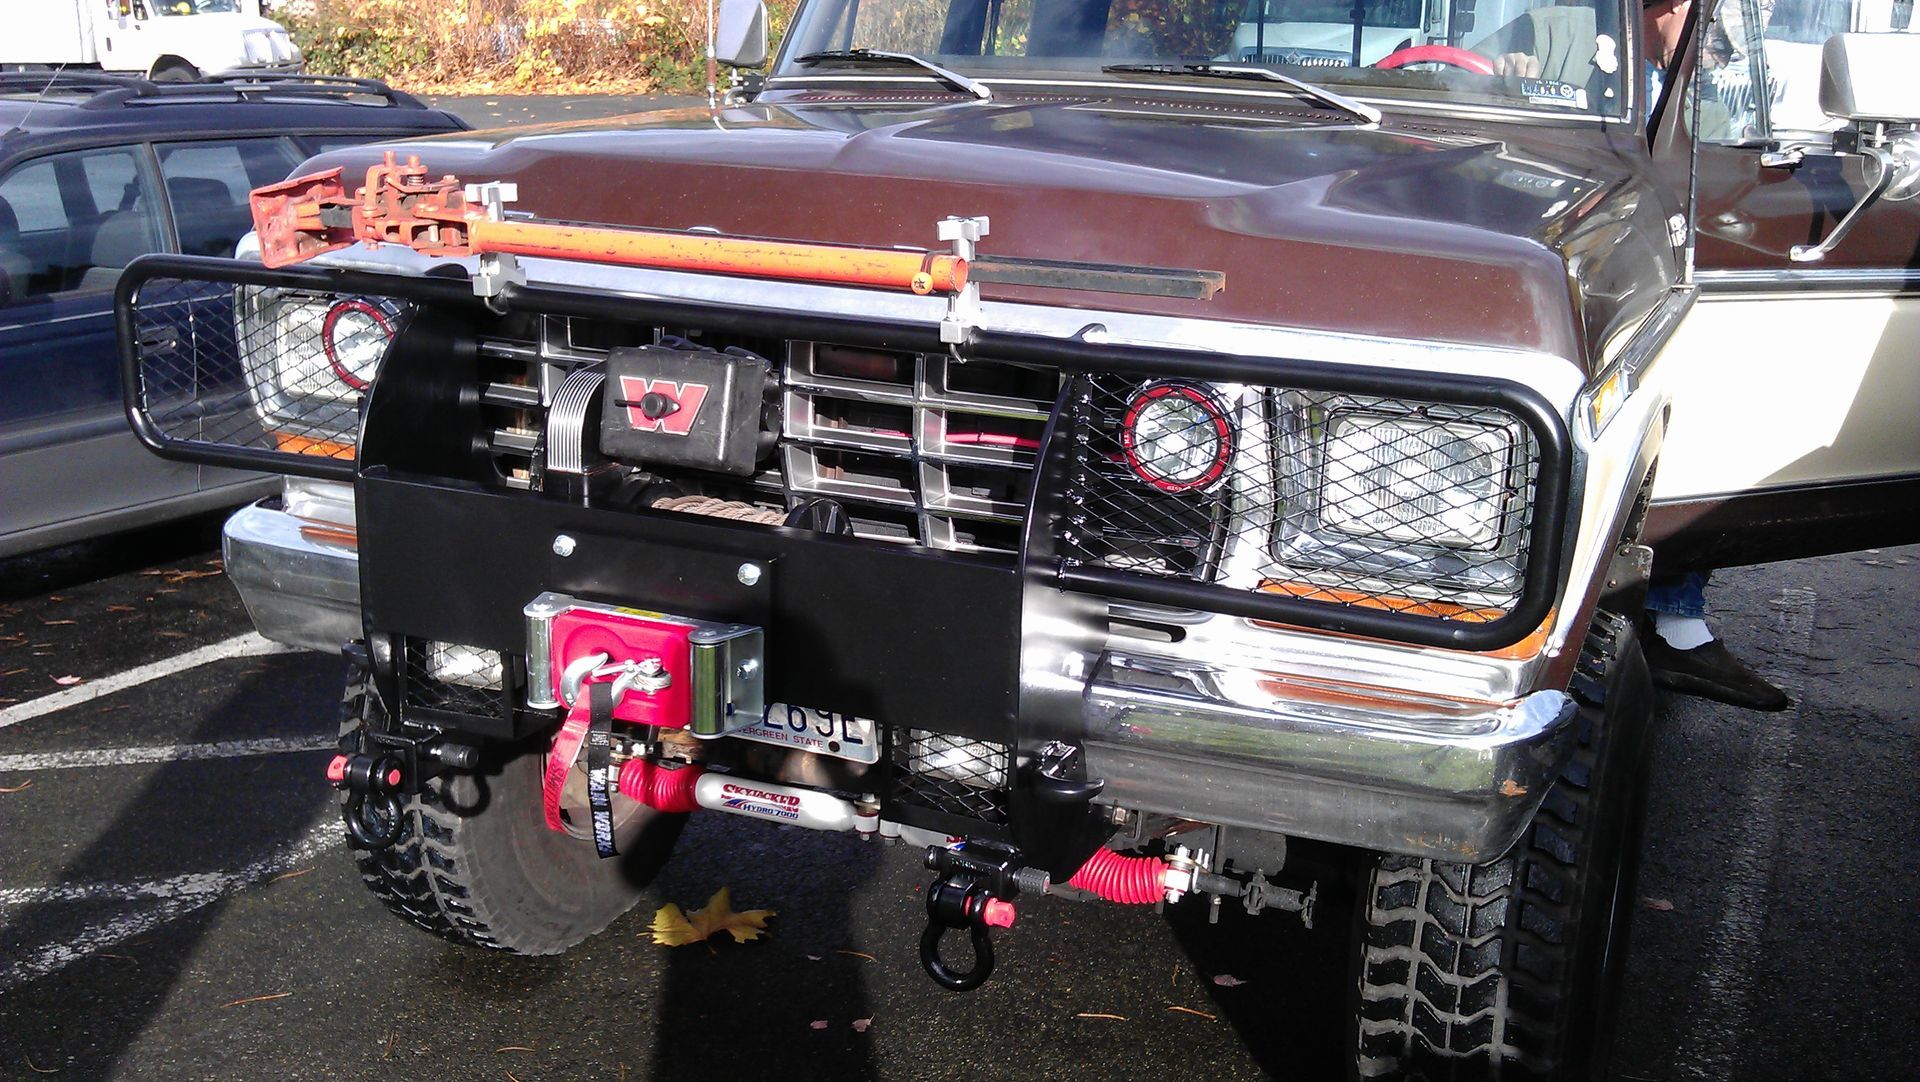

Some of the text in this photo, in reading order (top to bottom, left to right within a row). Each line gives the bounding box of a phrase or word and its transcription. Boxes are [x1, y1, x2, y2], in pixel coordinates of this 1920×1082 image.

[793, 736, 824, 749] STATE
[743, 804, 774, 816] HYDRO
[774, 809, 799, 820] 7000
